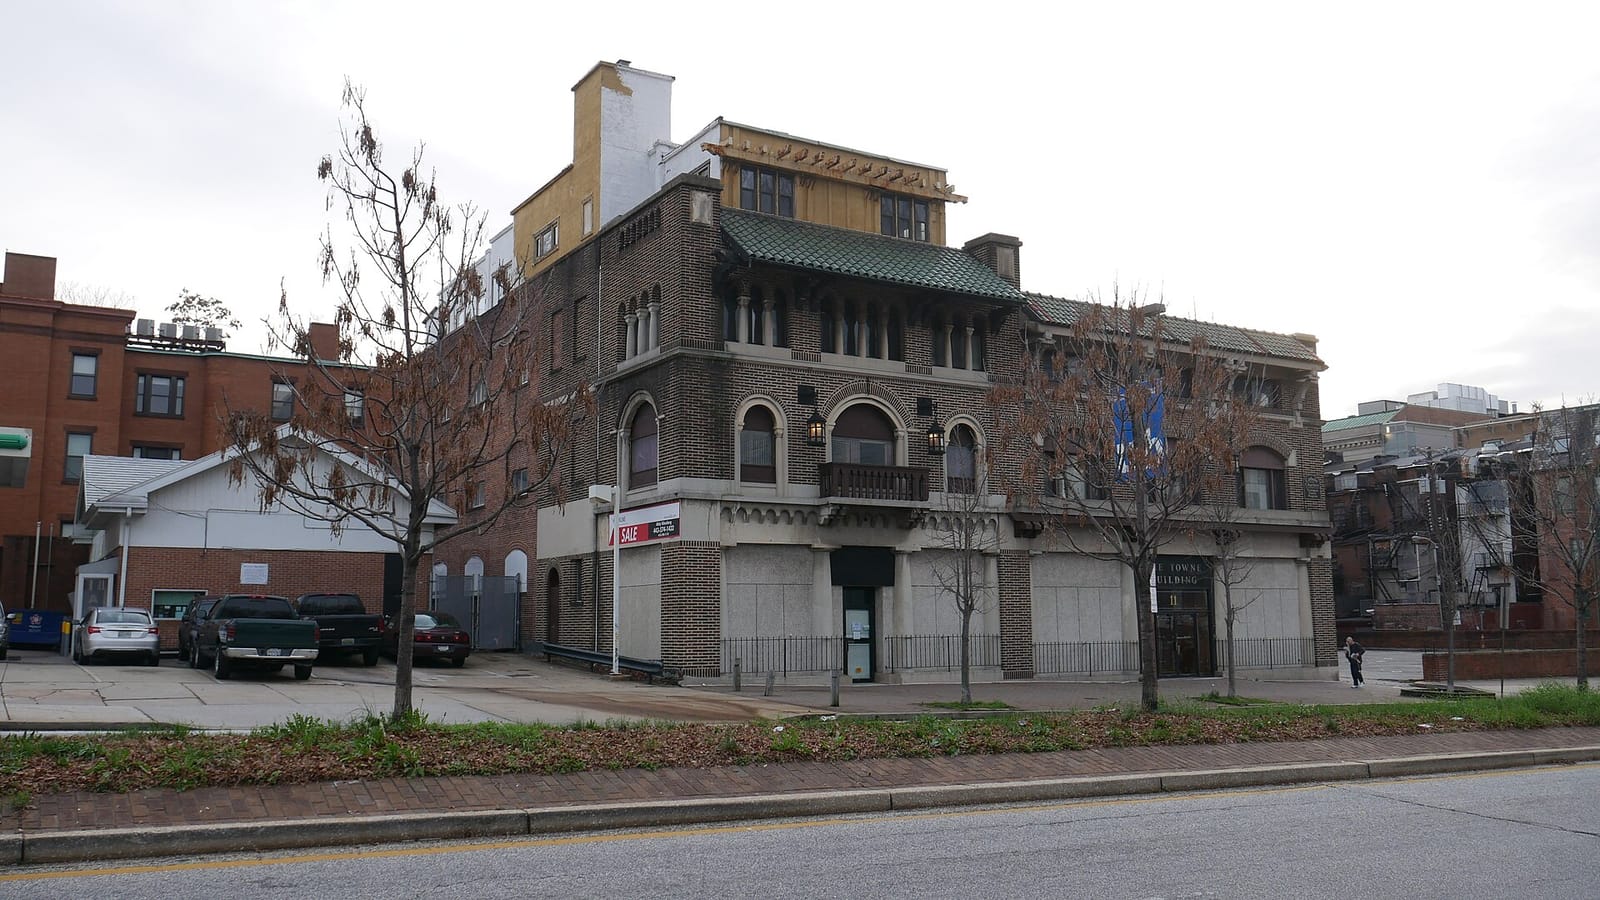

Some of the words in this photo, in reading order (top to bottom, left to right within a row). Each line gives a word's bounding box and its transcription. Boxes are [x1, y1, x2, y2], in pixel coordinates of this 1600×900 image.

[621, 526, 638, 543] SALE
[1170, 563, 1201, 572] TOWNE
[1157, 575, 1197, 585] UILDING
[1170, 594, 1177, 606] 11
